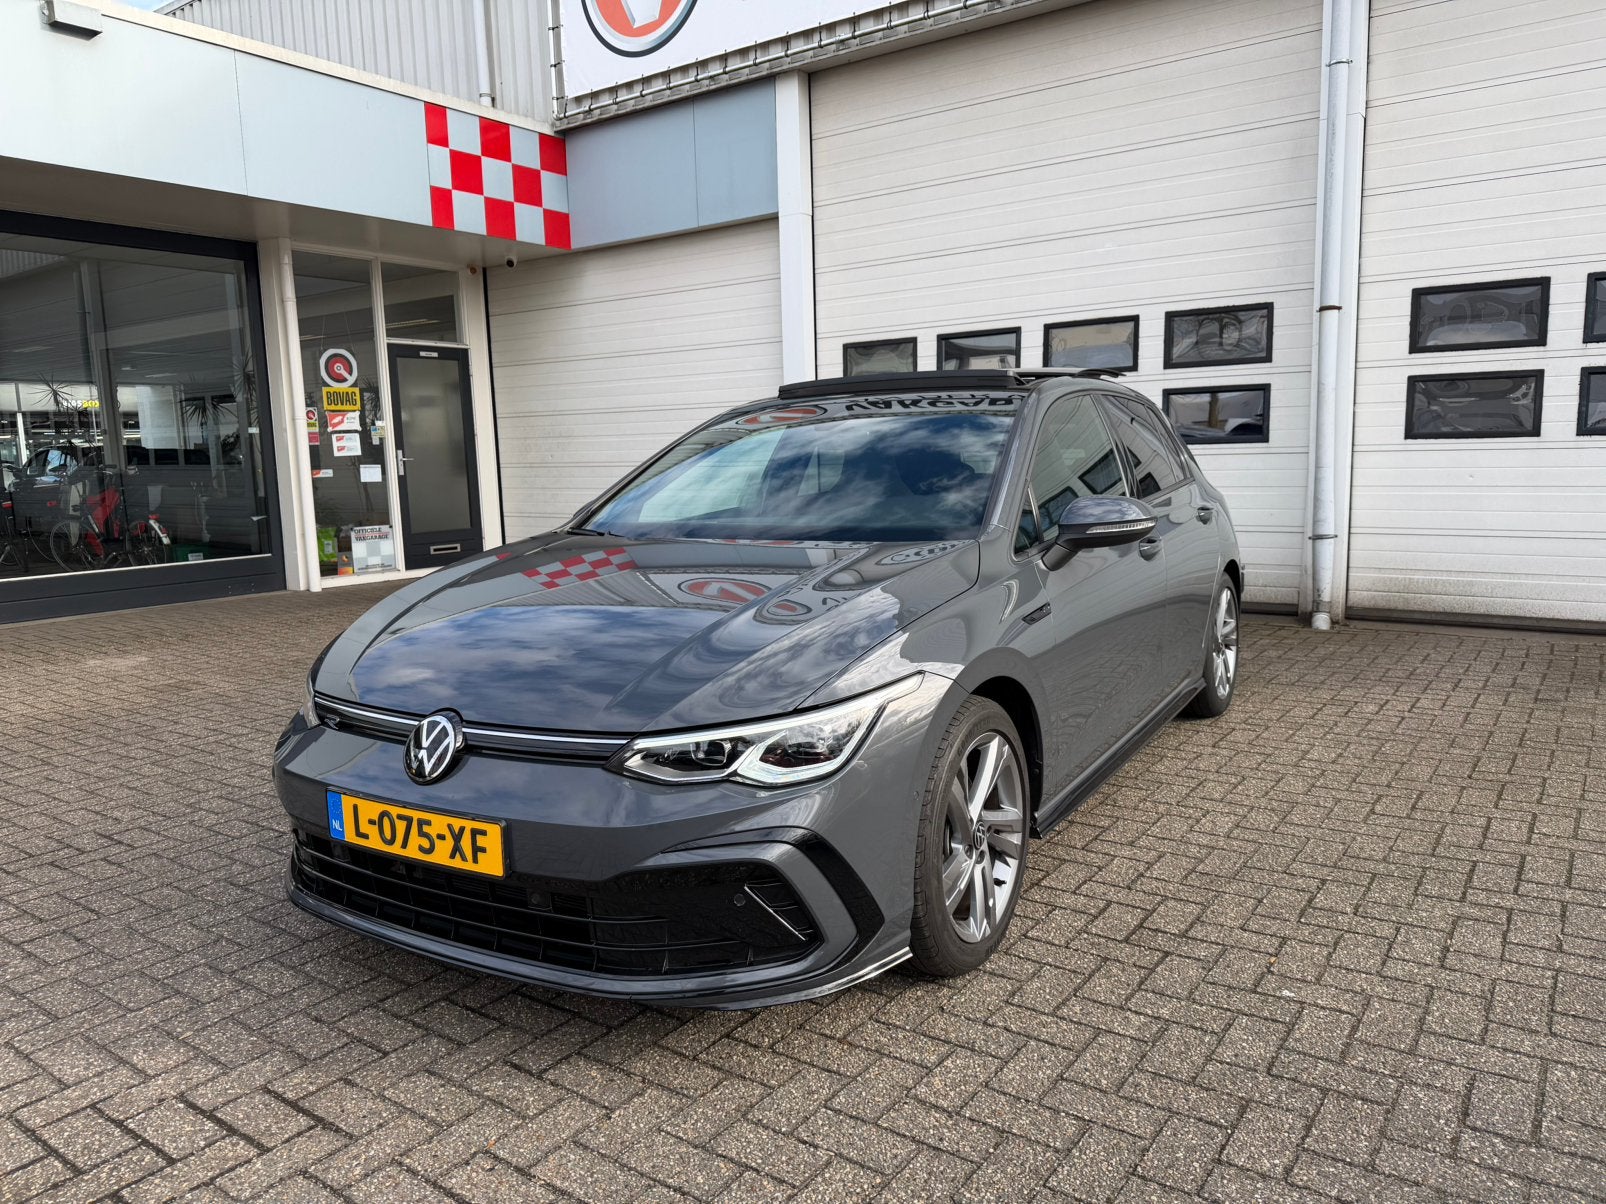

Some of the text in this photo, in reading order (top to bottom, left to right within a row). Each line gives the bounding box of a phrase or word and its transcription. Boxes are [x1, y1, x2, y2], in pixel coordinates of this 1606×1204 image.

[326, 391, 357, 406] BOVAG
[332, 819, 343, 832] NL
[352, 803, 488, 865] L-075-XF
